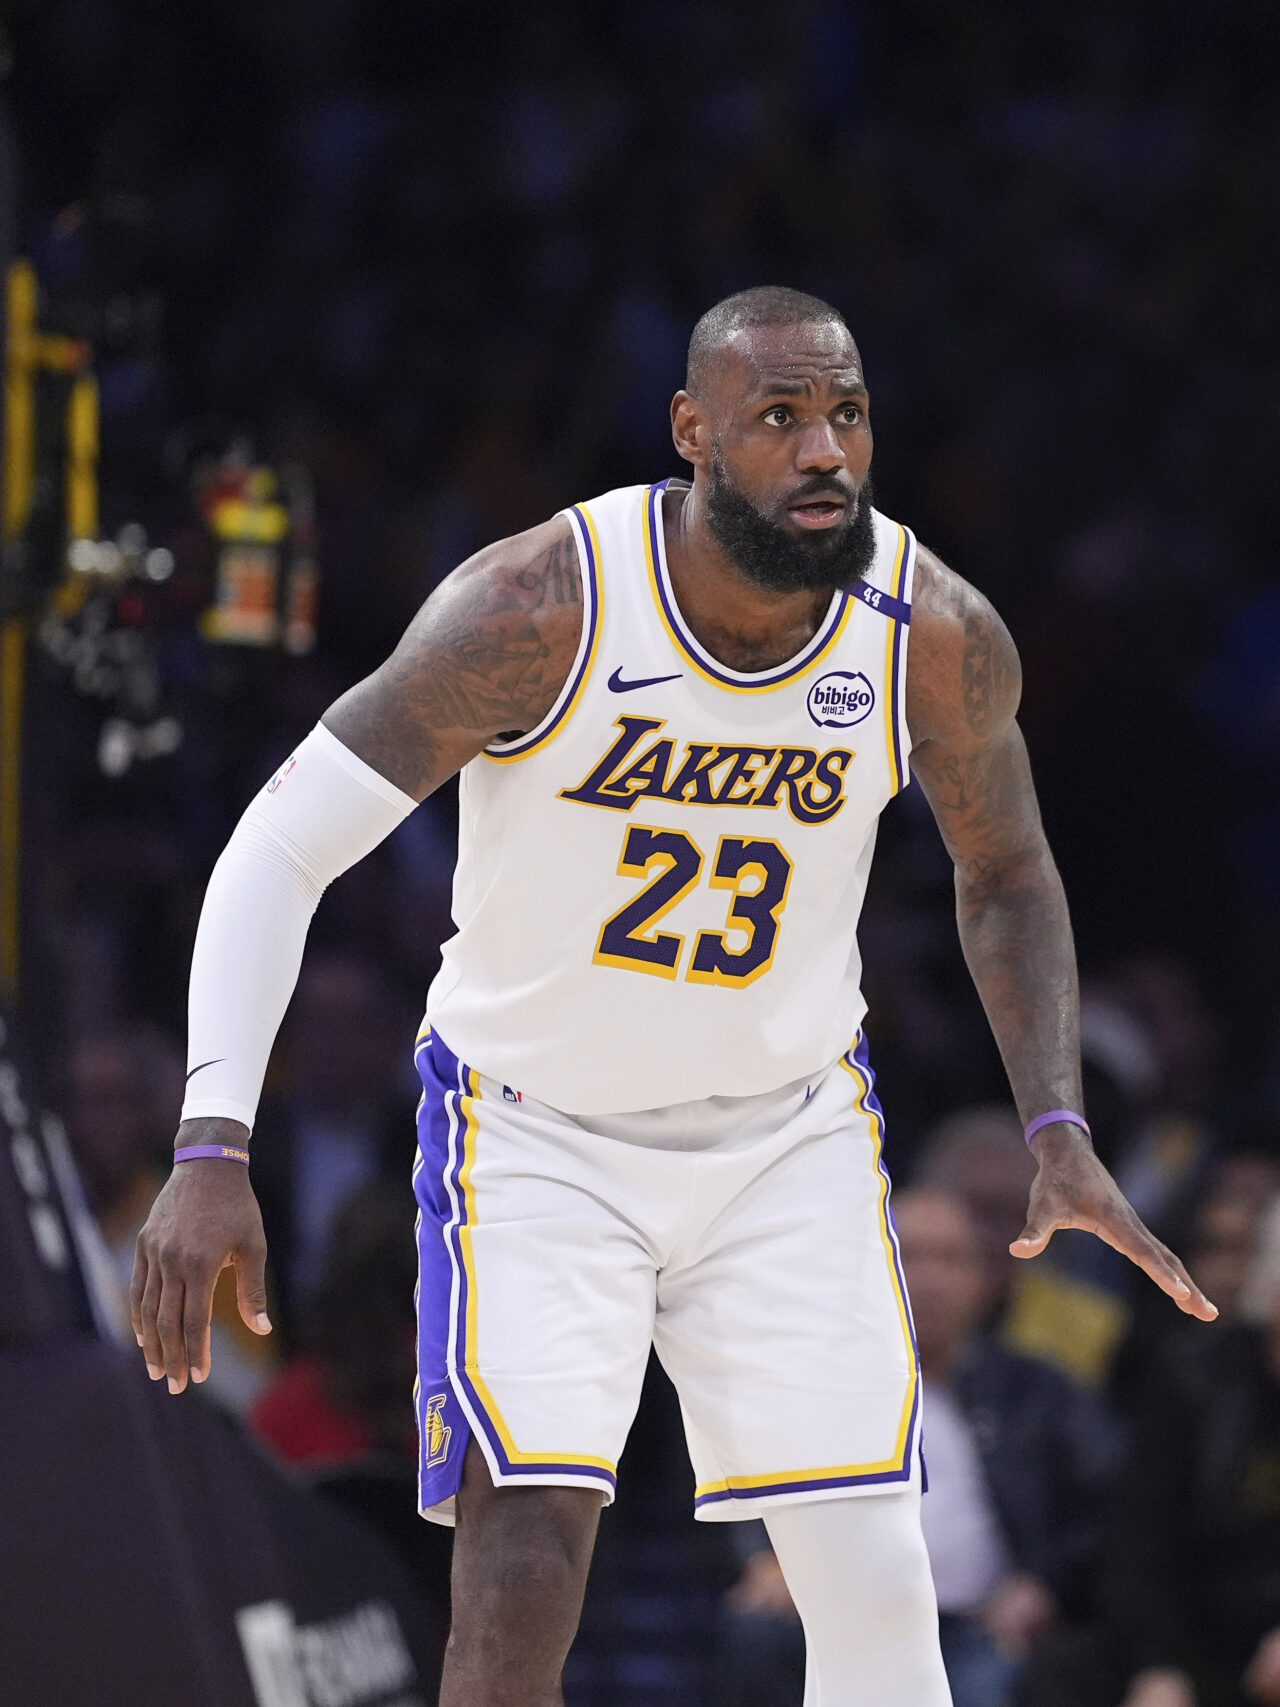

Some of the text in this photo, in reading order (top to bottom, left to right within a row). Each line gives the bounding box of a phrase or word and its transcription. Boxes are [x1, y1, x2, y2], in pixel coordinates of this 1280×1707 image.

[863, 586, 882, 608] 44
[813, 686, 871, 712] bibigo
[821, 705, 845, 716] 비비고
[556, 713, 856, 827] LAKERS
[592, 823, 795, 990] 23
[221, 1148, 249, 1161] OMISE
